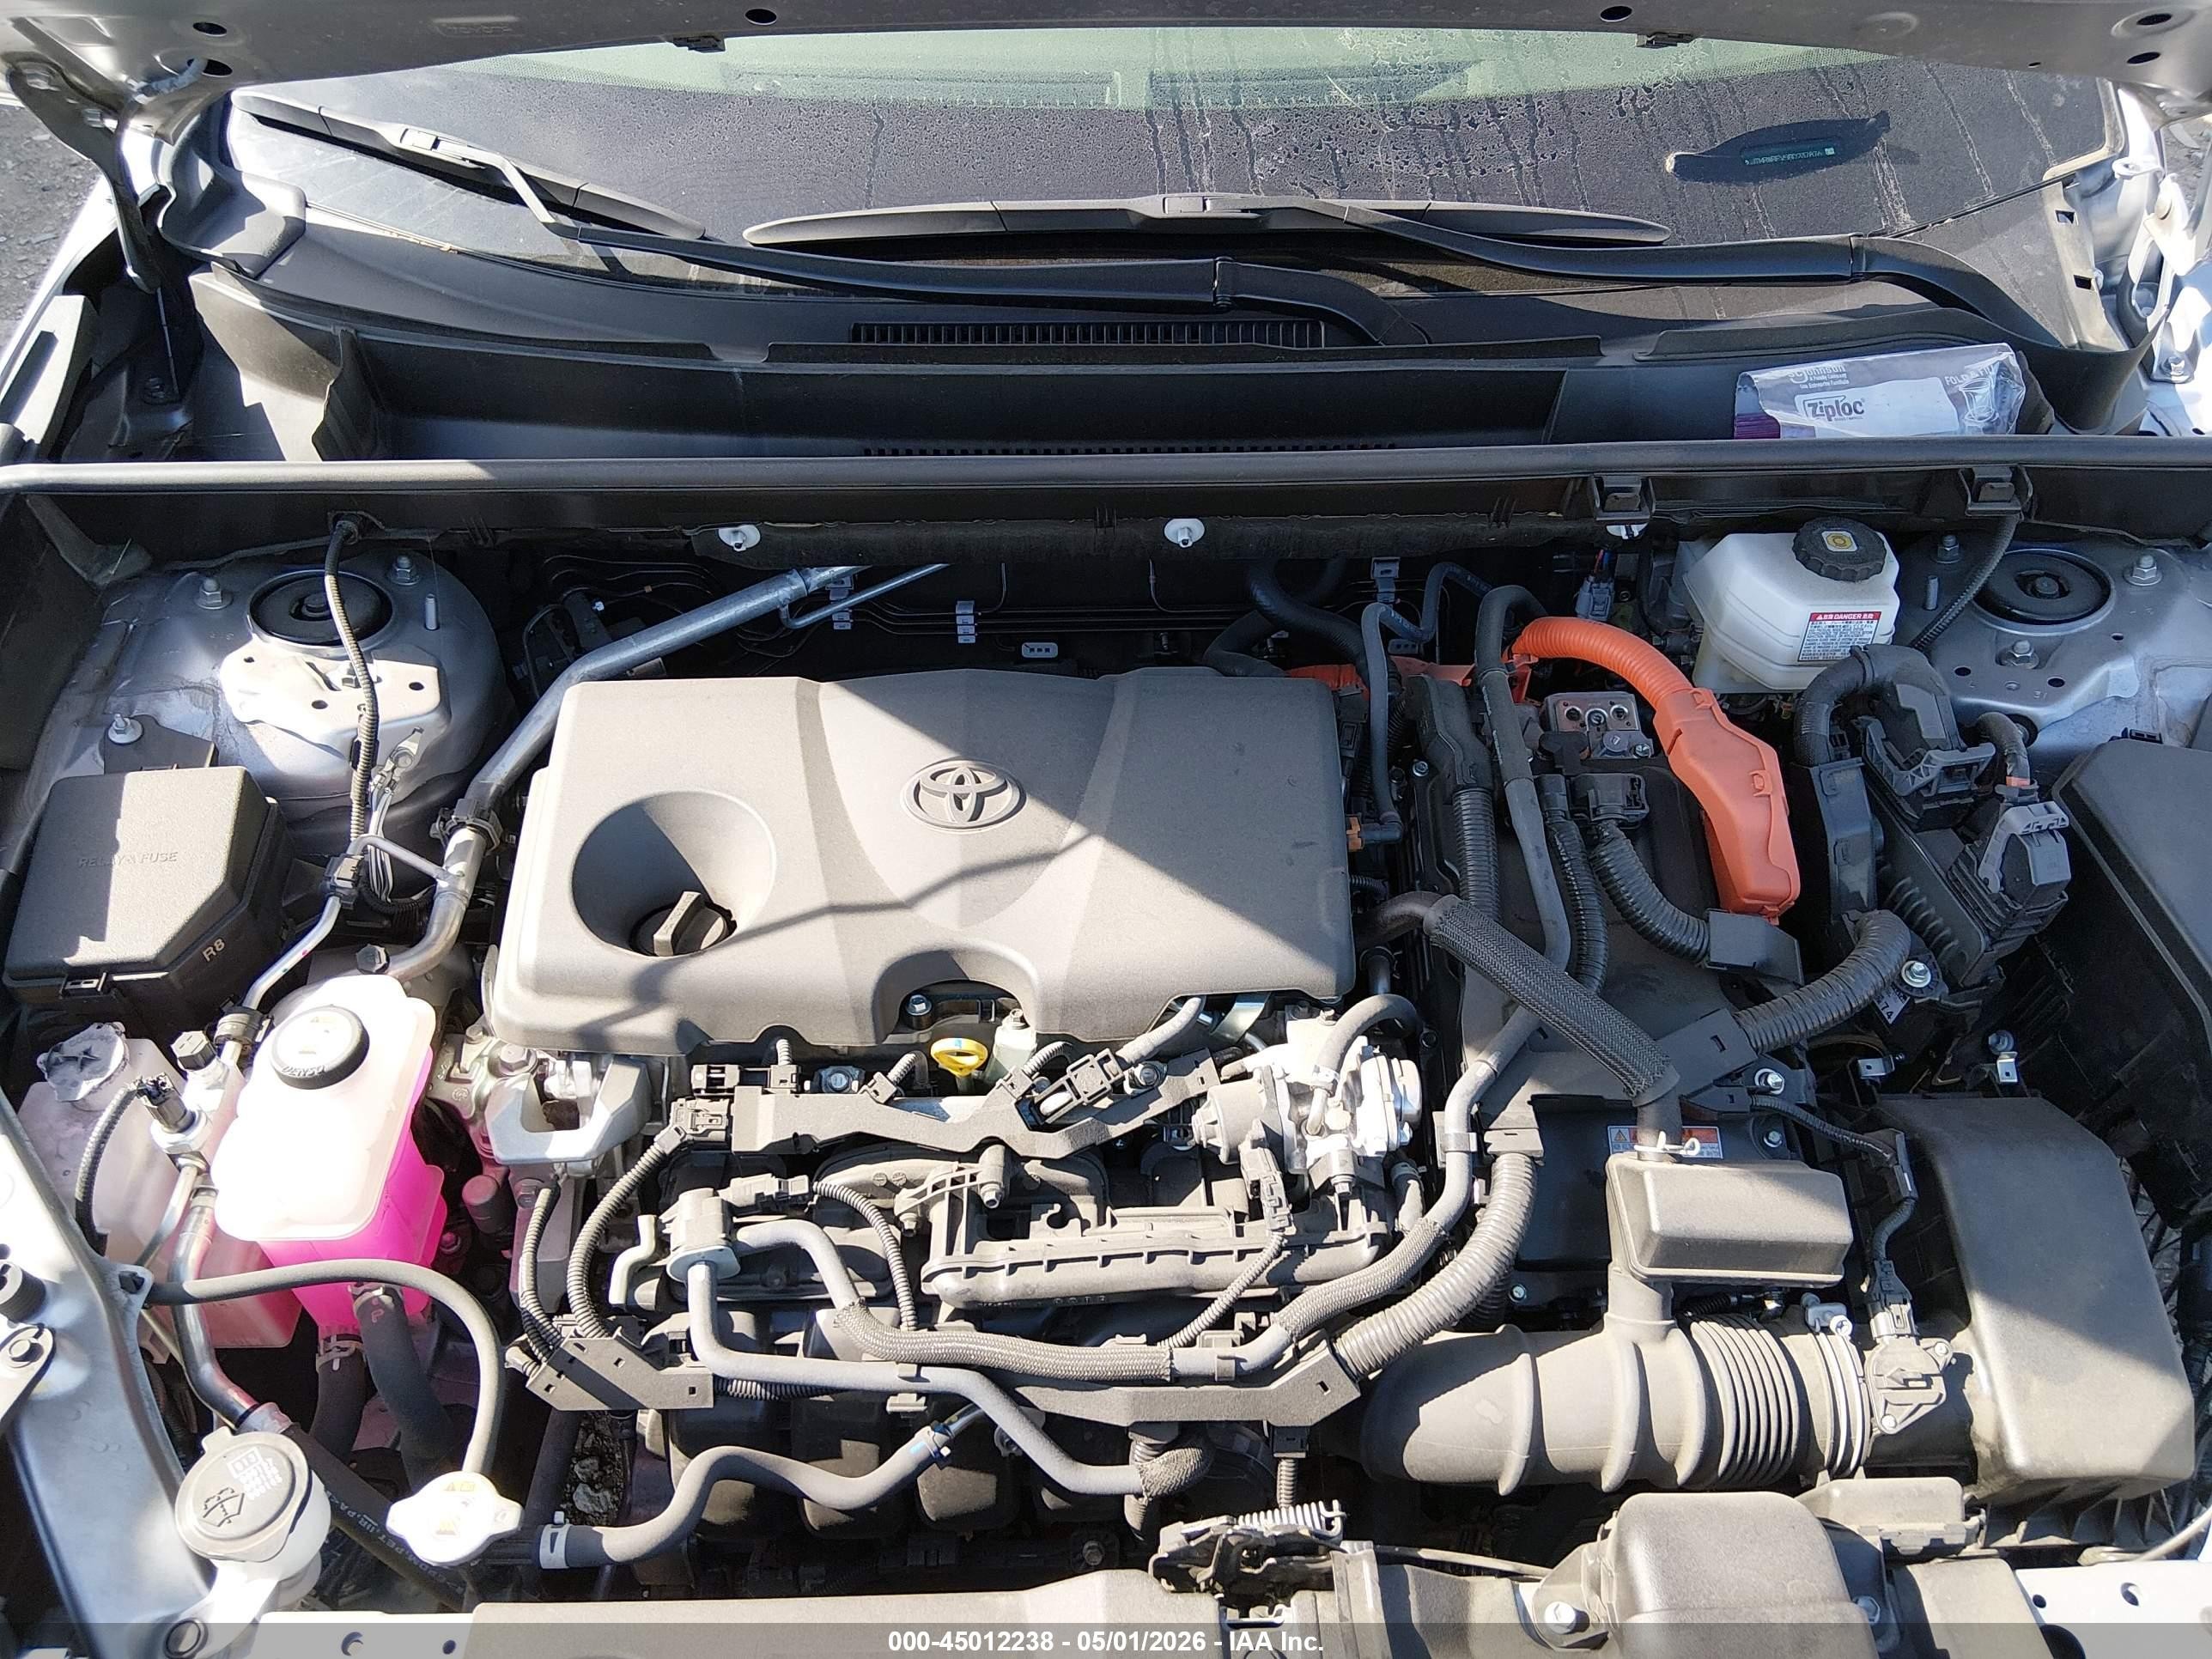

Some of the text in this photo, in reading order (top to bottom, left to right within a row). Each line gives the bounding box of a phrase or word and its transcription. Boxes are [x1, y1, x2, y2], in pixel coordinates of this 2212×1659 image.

[1808, 398, 1864, 422] Ziploc
[140, 851, 179, 864] FUSE
[202, 938, 225, 963] R8
[282, 1065, 326, 1077] DENSO
